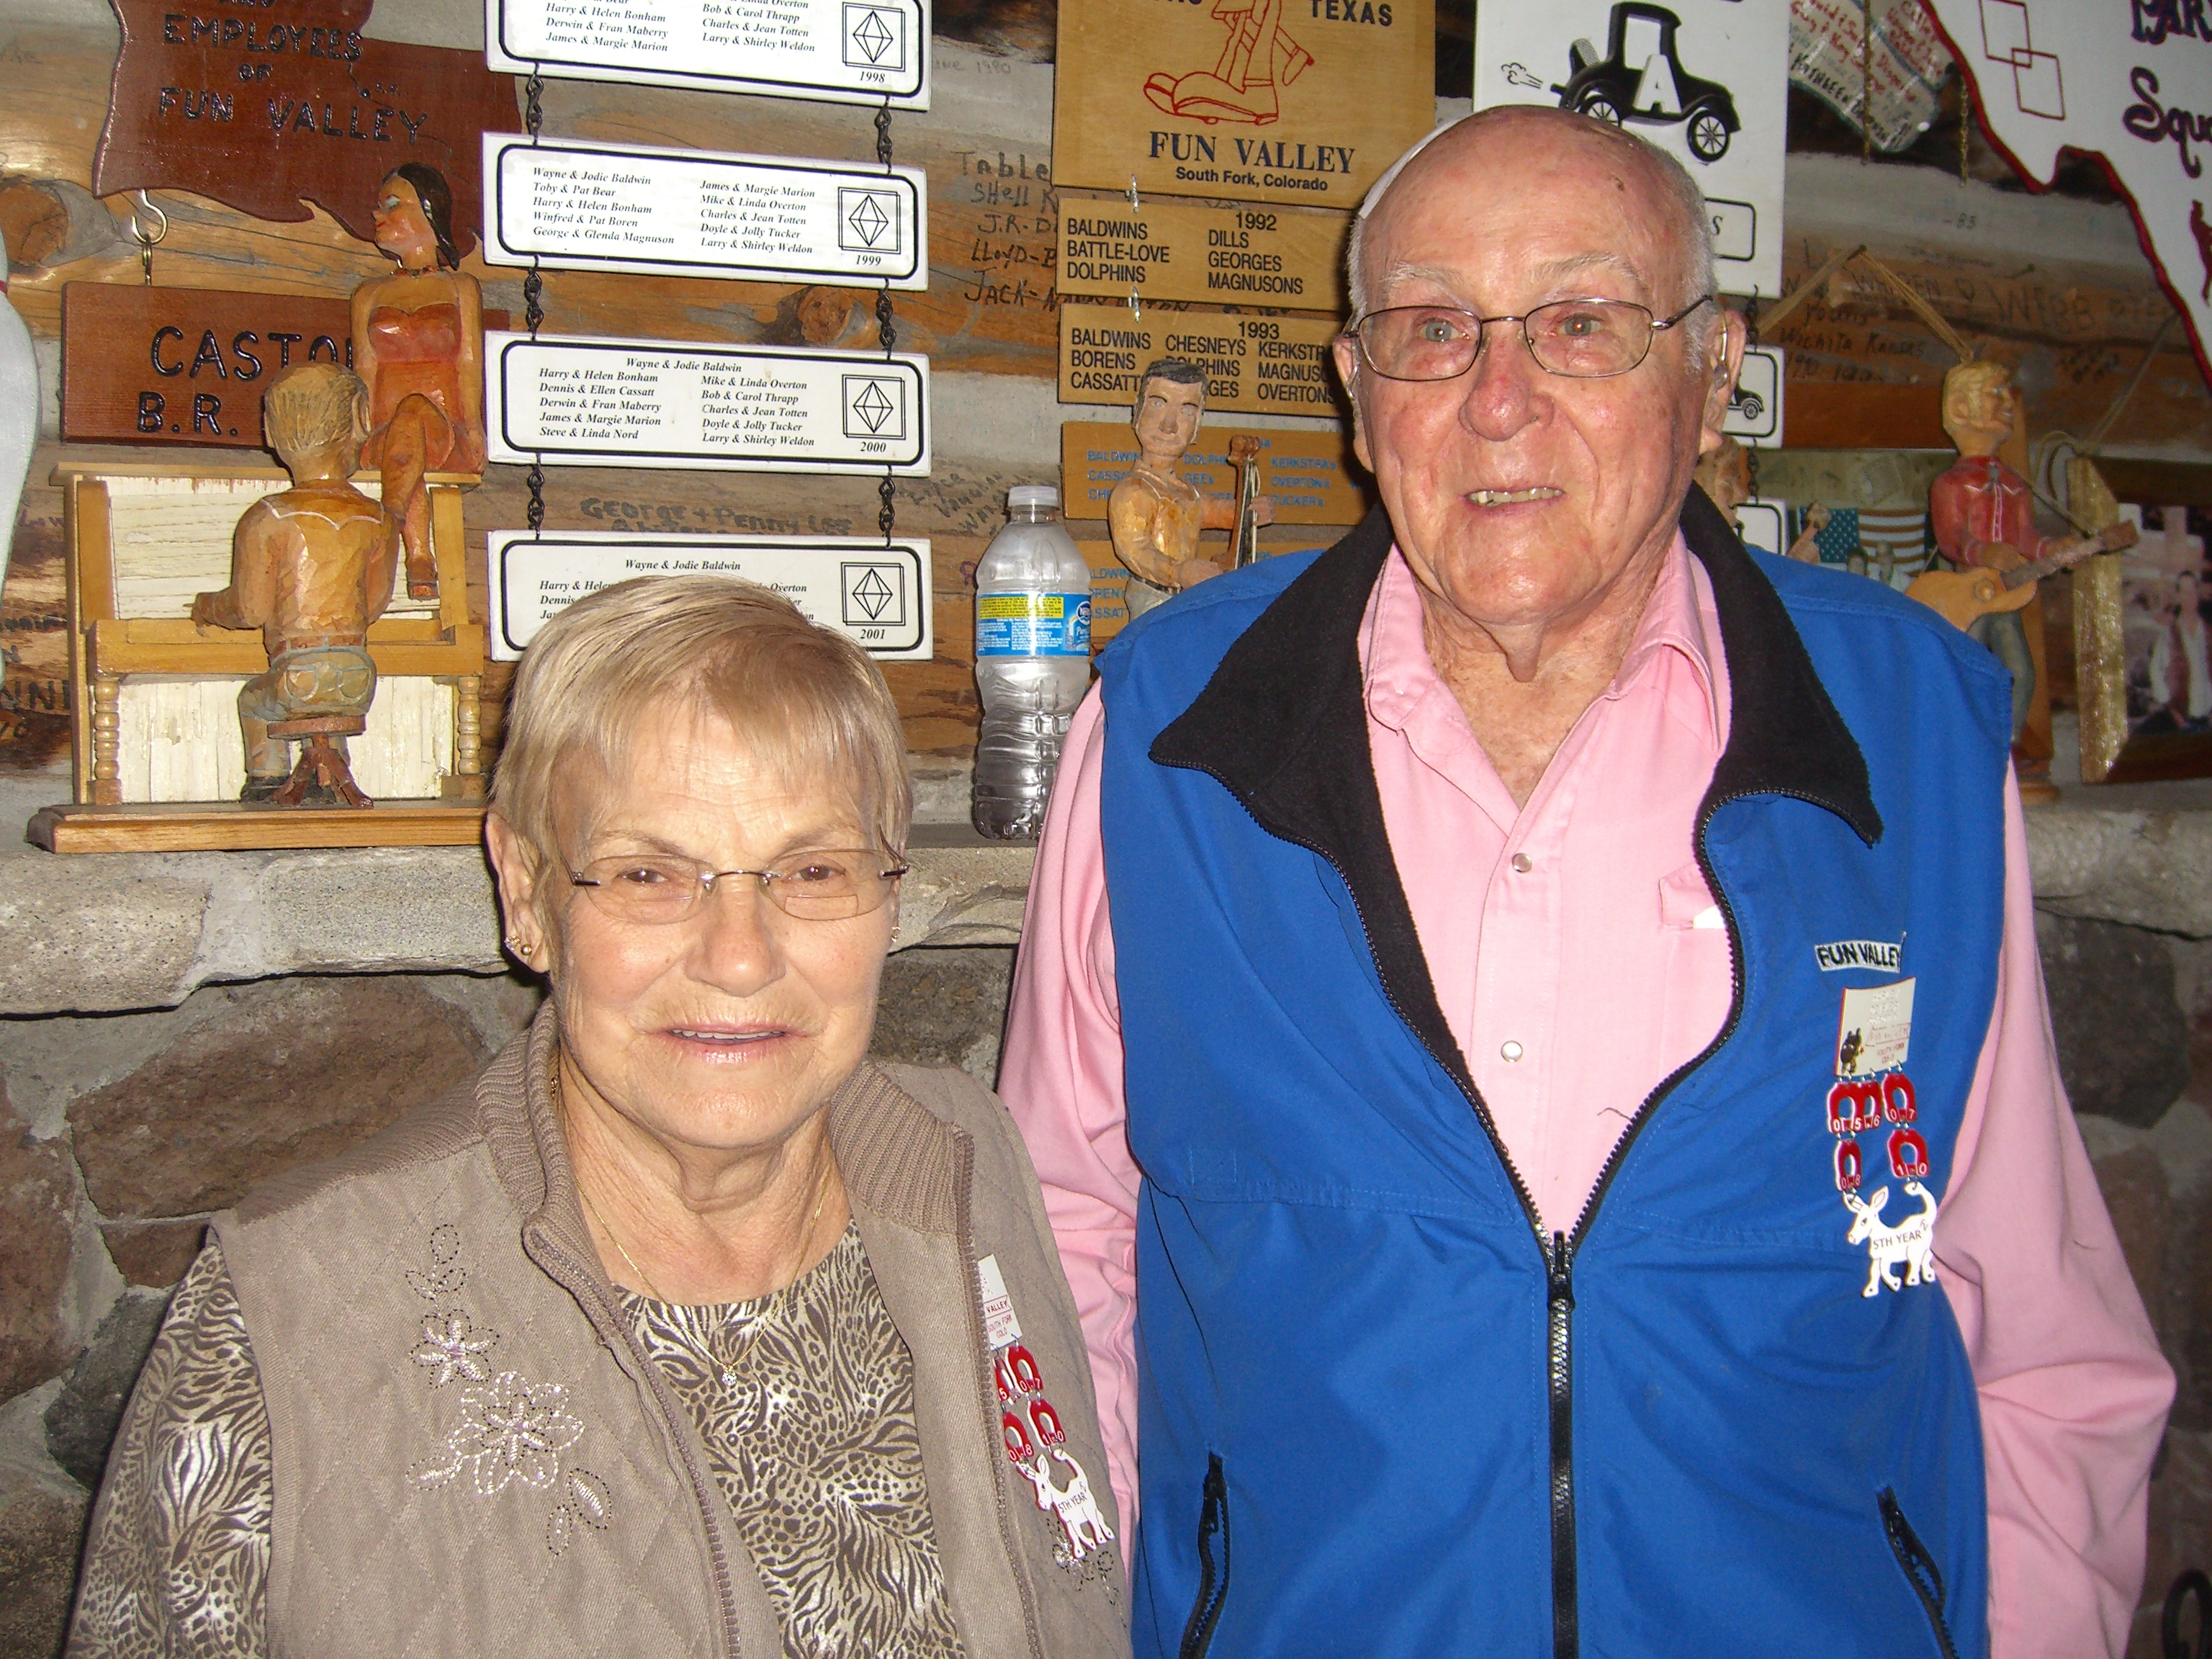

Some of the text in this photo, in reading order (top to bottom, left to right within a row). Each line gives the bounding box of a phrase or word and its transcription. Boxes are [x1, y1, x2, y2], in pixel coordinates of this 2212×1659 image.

[546, 2, 666, 22] Harry Helen Bonham
[702, 3, 801, 24] Bob Carol Thrapp
[1311, 0, 1393, 27] TEXAS
[546, 17, 669, 40] Derwin Fran Maberry
[702, 17, 809, 37] Charles Jean Totten
[163, 13, 363, 63] EMPLOYEES
[545, 32, 668, 52] James Margie Marion
[702, 32, 815, 52] Larry Shirley Weldon
[237, 63, 273, 84] OF
[860, 71, 886, 84] 1998
[158, 86, 428, 145] FUN VALLEY
[1148, 130, 1357, 175] FUN VALLEY
[533, 166, 651, 185] Wayne Jodie Baldwin
[1176, 166, 1329, 192] South Fork, Colorado
[534, 181, 616, 197] Toby Pat Bear
[699, 179, 815, 198] James Margie Marion
[532, 196, 652, 214] Harry Helen Bonham
[700, 194, 806, 212] Mike Linda Overton
[534, 211, 638, 228] Winfred Pat Boren
[700, 208, 806, 225] Charles Jean Totten
[1235, 211, 1277, 231] 1992
[533, 225, 675, 245] George Glenda Magnuson
[700, 222, 801, 239] Doyle Jolly Tucker
[1067, 217, 1148, 240] BALDWINS
[701, 237, 813, 254] Larry Shirley Weldon
[1208, 229, 1250, 249] DILLS
[855, 254, 882, 267] 1999
[1067, 240, 1171, 264] BATTLE-LOVE
[1208, 251, 1282, 273] GEORGES
[1067, 261, 1146, 284] DOLPHINS
[1208, 271, 1304, 295] MAGNUSONS
[1071, 328, 1151, 351] BALDWINS
[1237, 320, 1280, 340] 1993
[150, 325, 354, 382] CASTO
[1165, 333, 1247, 357] CHESNEYS
[1258, 341, 1327, 362] KERKSTR
[626, 356, 743, 372] Wayne Jodie Baldwin
[1071, 349, 1136, 370] BORENS
[539, 367, 659, 382] Harry Helen Bonham
[701, 375, 807, 390] Mike Linda Overton
[1071, 372, 1143, 393] CASSATT
[539, 382, 655, 397] Dennis Ellen Cassatt
[701, 390, 799, 406] Bob Carol Thrapp
[539, 397, 662, 414] Derwin Fran Maberry
[701, 403, 808, 418] Charles Jean Totten
[539, 411, 662, 427] James Margie Marion
[701, 418, 803, 433] Doyle Jolly Tucker
[539, 426, 639, 439] Steve Linda Nord
[701, 431, 815, 447] Larry Shirley Weldon
[860, 441, 887, 454] 2000
[1087, 449, 1143, 462] BALDWIN
[625, 559, 741, 572] Wayne Jodie Baldwin
[539, 580, 570, 593] Harry
[770, 582, 807, 593] Overton
[539, 595, 577, 606] Dennis
[860, 628, 886, 640] 2001
[1816, 943, 1858, 968] FUN
[1872, 1228, 1923, 1251] 5TH YEAR
[986, 1299, 1008, 1314] VALLEY
